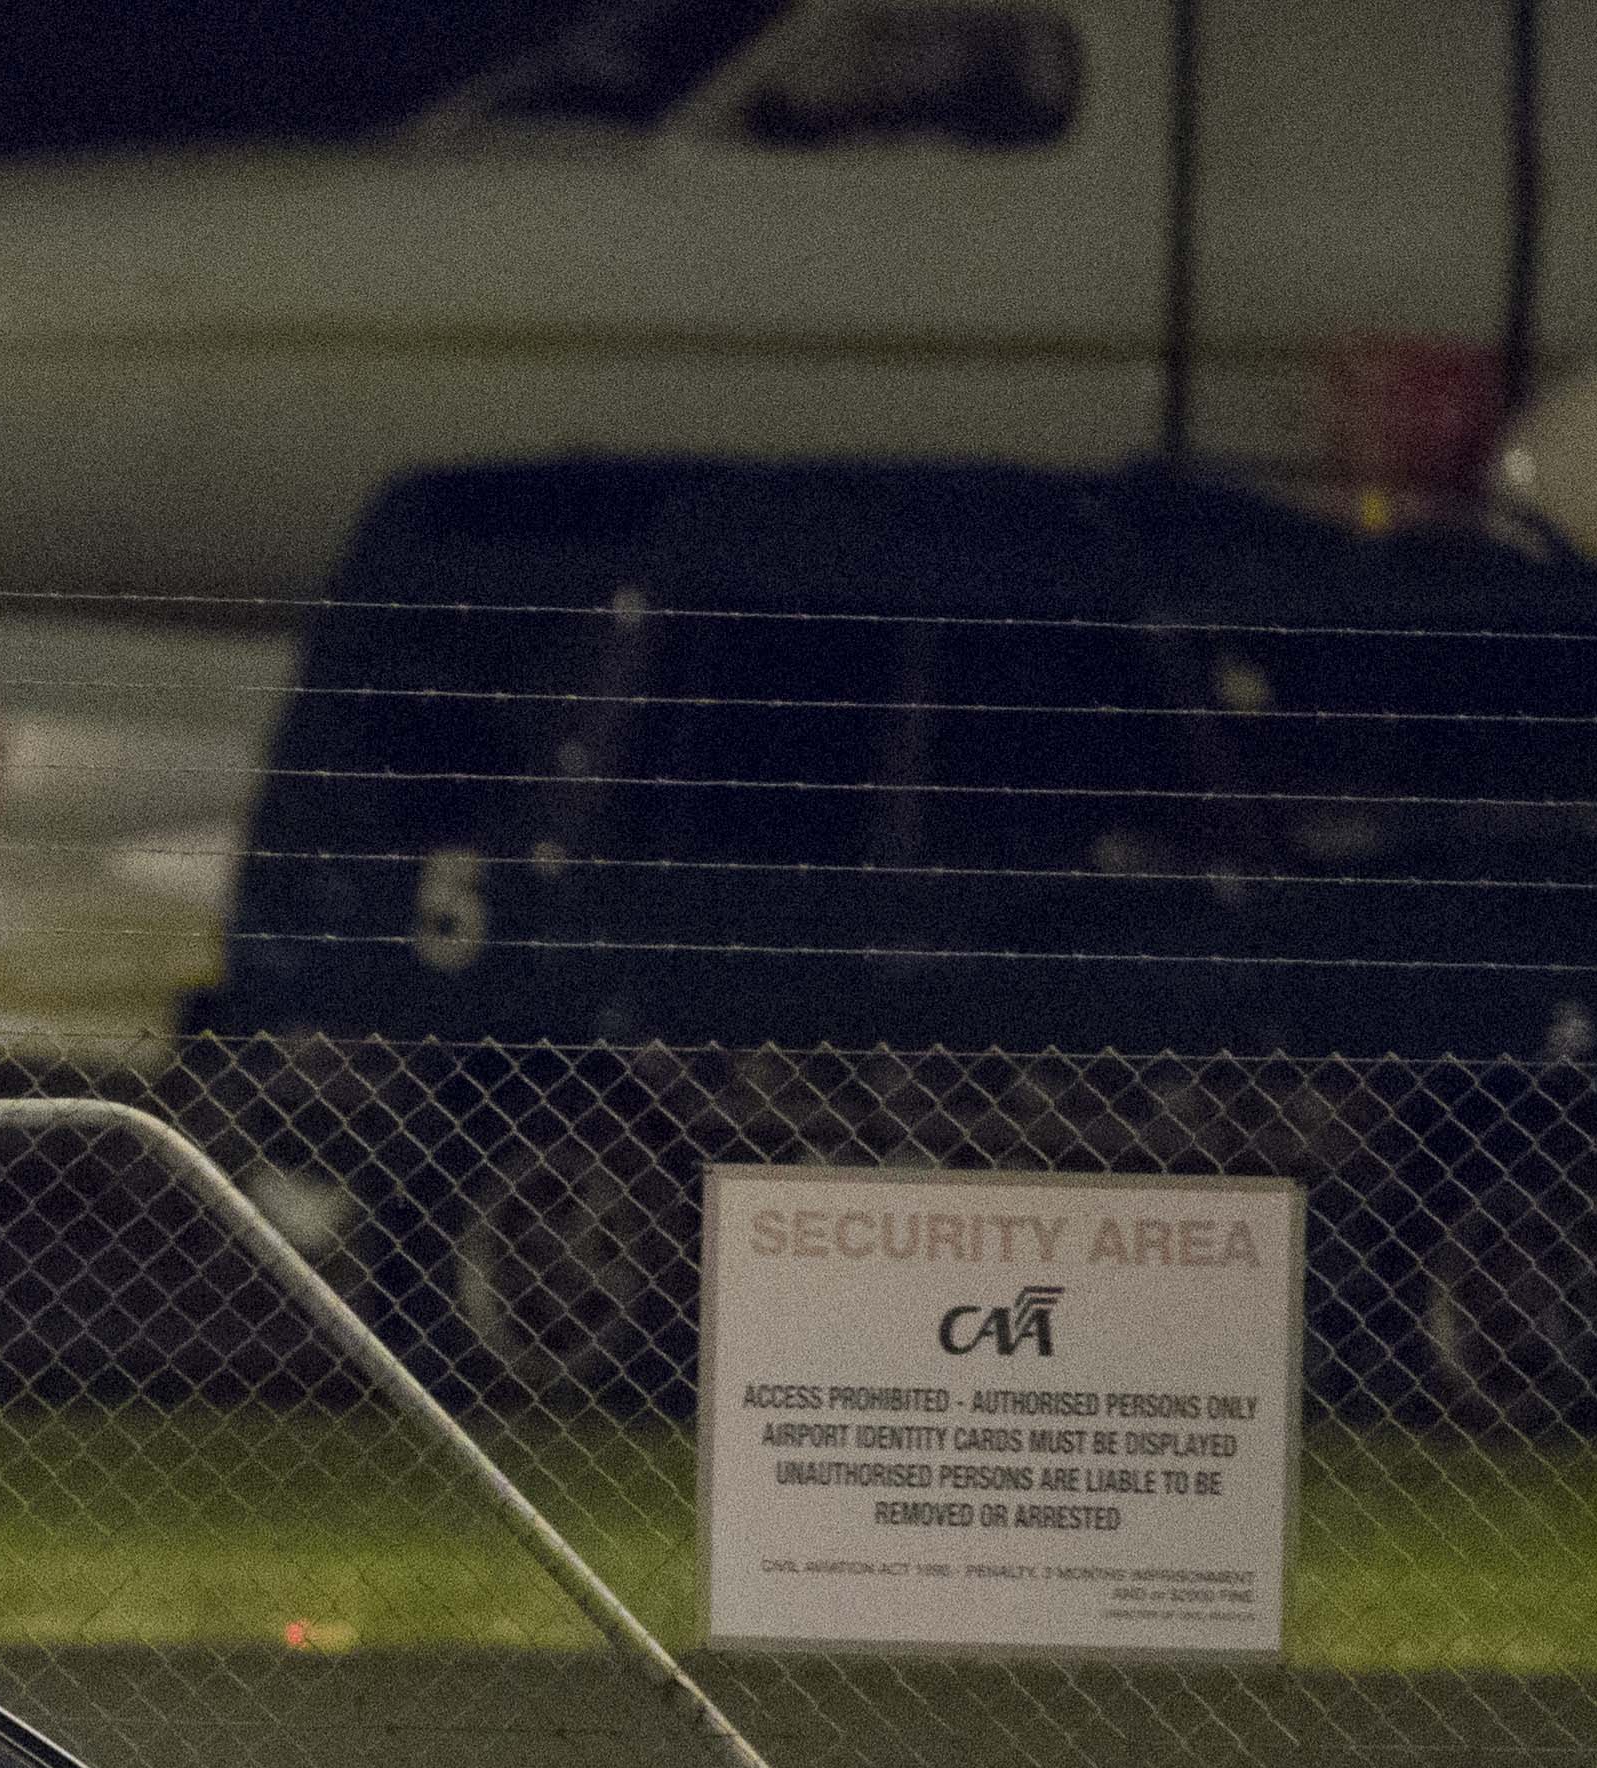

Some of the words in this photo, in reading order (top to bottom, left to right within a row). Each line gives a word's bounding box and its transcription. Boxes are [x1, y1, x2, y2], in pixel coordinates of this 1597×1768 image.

[750, 1209, 1068, 1264] SECURITY
[1088, 1218, 1262, 1268] AREA
[939, 1286, 1065, 1357] CAA
[744, 1384, 822, 1409] ACCESS
[829, 1386, 949, 1412] PROHIBITED
[971, 1389, 1099, 1416] AUTHORISED
[1106, 1392, 1201, 1419] PERSONS
[1207, 1394, 1257, 1420] ONLY
[762, 1422, 849, 1448] AIRPORT
[856, 1424, 946, 1450] IDENTITY
[954, 1427, 1023, 1453] CARDS
[1029, 1430, 1088, 1454] MUST
[1093, 1431, 1118, 1455] BE
[1125, 1432, 1237, 1457] DISPLAYED
[776, 1461, 932, 1488] UNAUTHORISED
[939, 1465, 1033, 1491] PERSONS
[1040, 1468, 1080, 1491] ARE
[1086, 1469, 1156, 1494] LIABLE
[1161, 1471, 1188, 1495] TO
[1194, 1471, 1222, 1496] BE
[875, 1501, 974, 1527] REMOVED
[981, 1503, 1008, 1528] OR
[1014, 1504, 1121, 1530] ARRESTED
